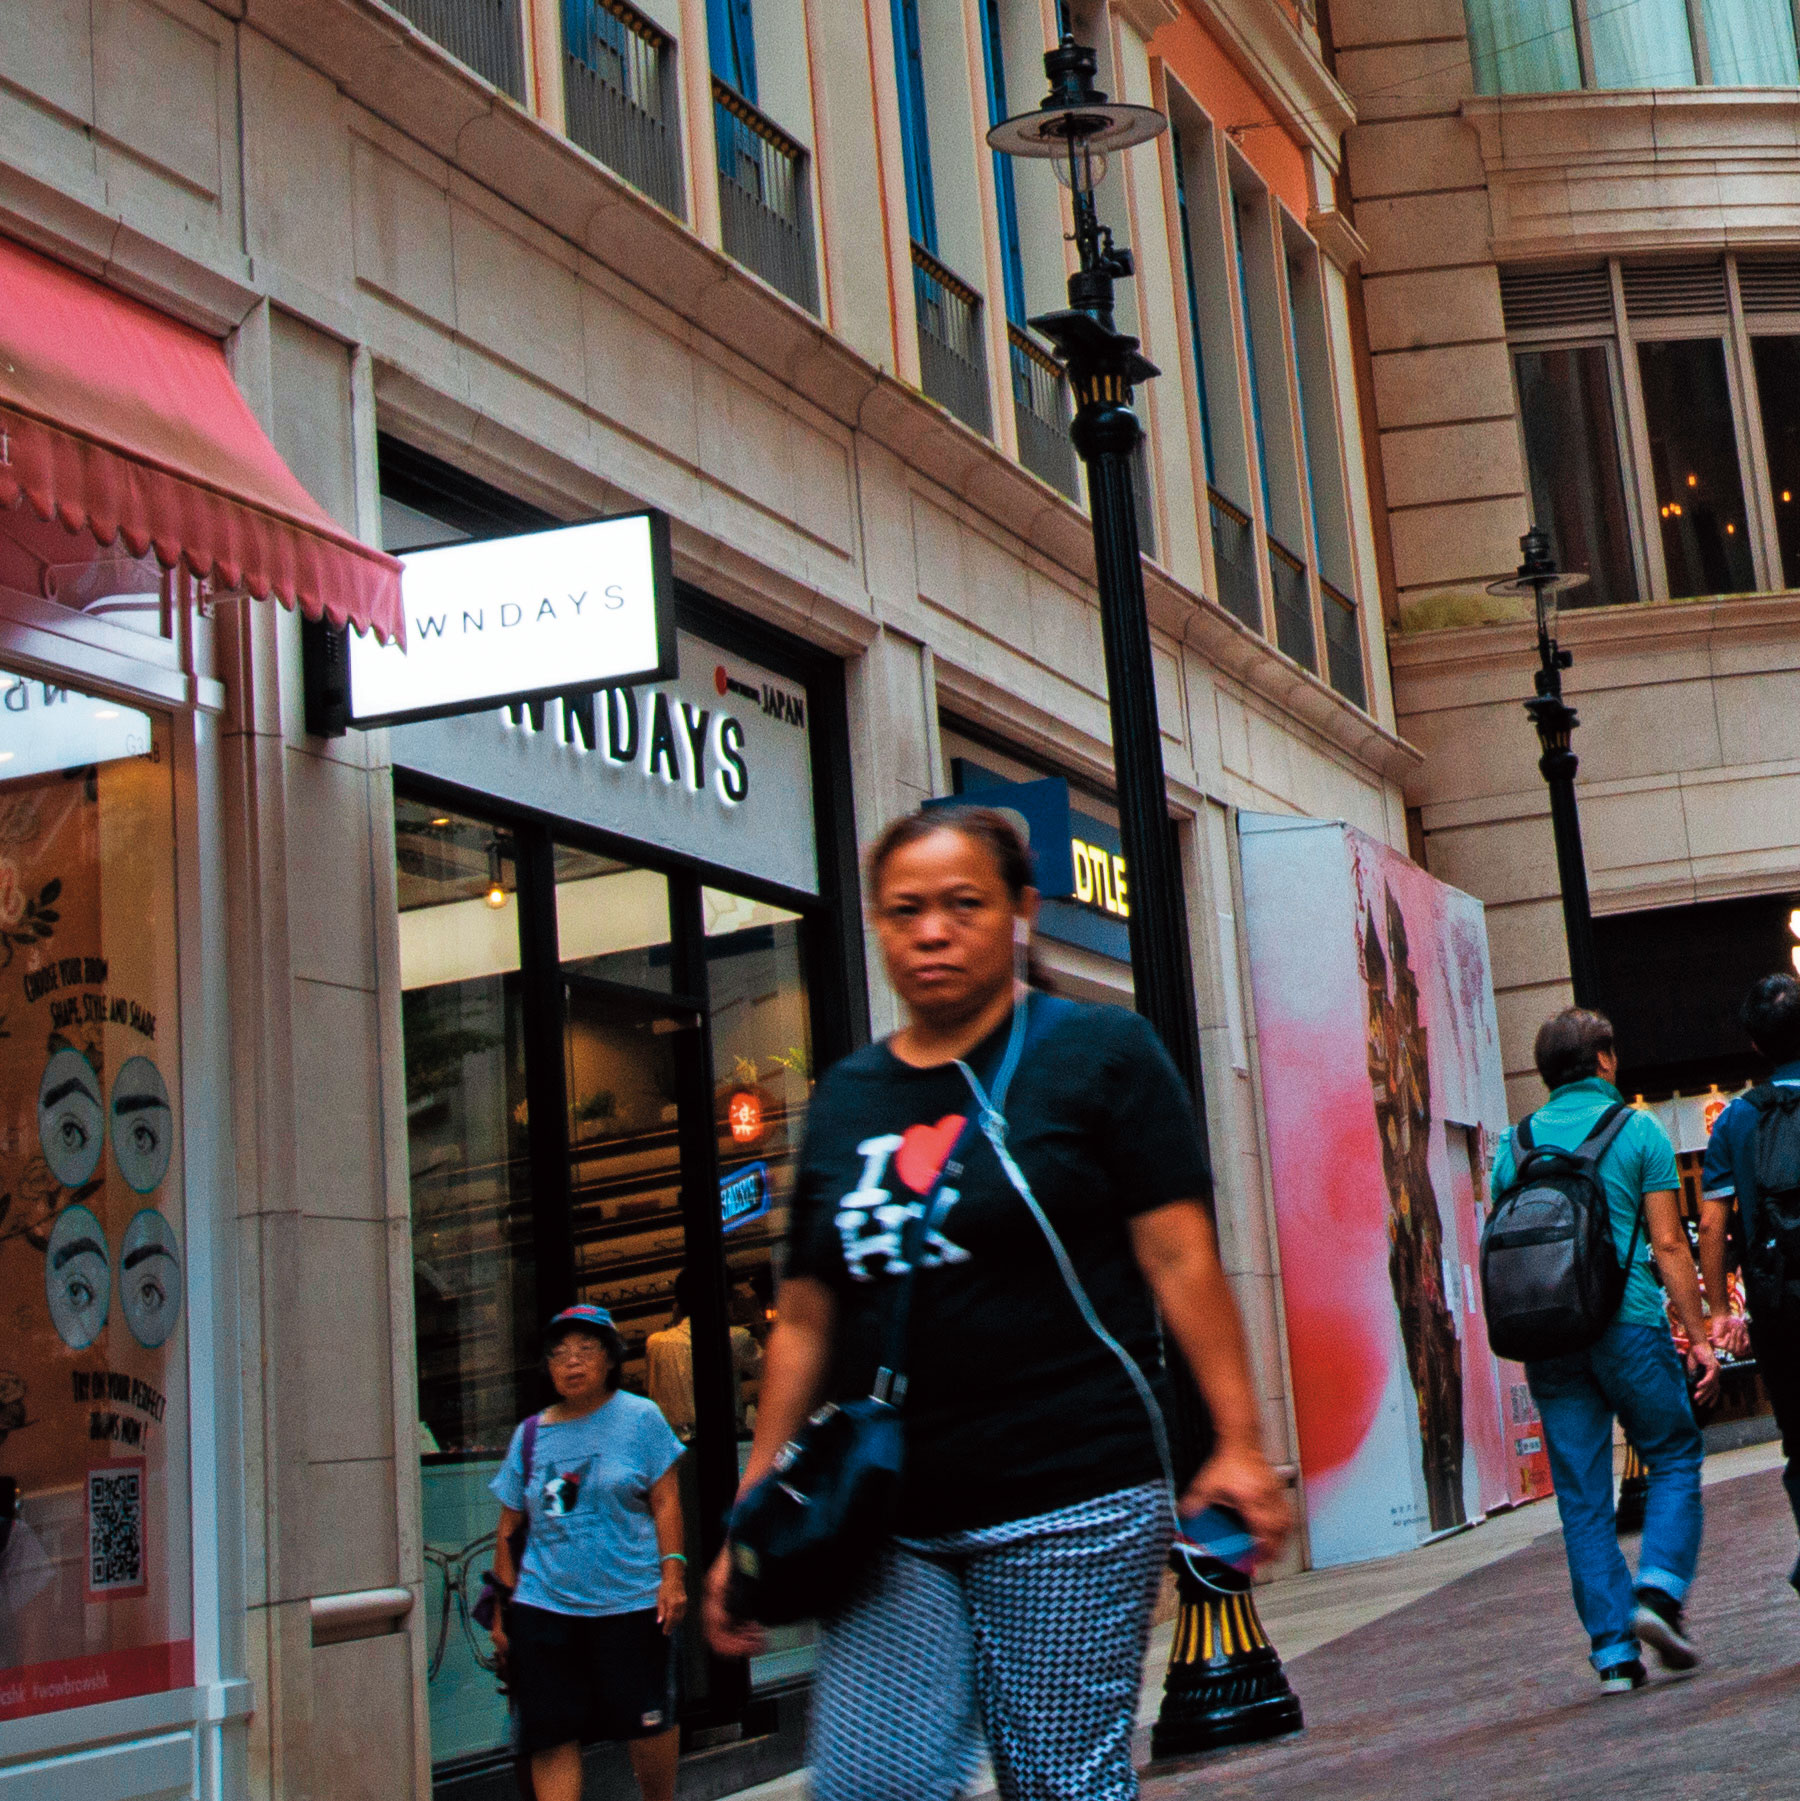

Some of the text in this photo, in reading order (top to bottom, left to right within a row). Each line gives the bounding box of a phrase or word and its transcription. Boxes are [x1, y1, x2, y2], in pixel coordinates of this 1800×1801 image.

[388, 584, 625, 647] WNDAYS
[762, 684, 805, 729] JAPAN
[1071, 838, 1129, 917] DTLE
[58, 957, 82, 986] YOUR
[83, 993, 107, 1023] STYLE
[109, 995, 128, 1025] AND
[130, 1000, 156, 1041] SHADE
[840, 1133, 904, 1208] I
[107, 1371, 130, 1402] YOUR
[131, 1377, 166, 1423] PERFECT
